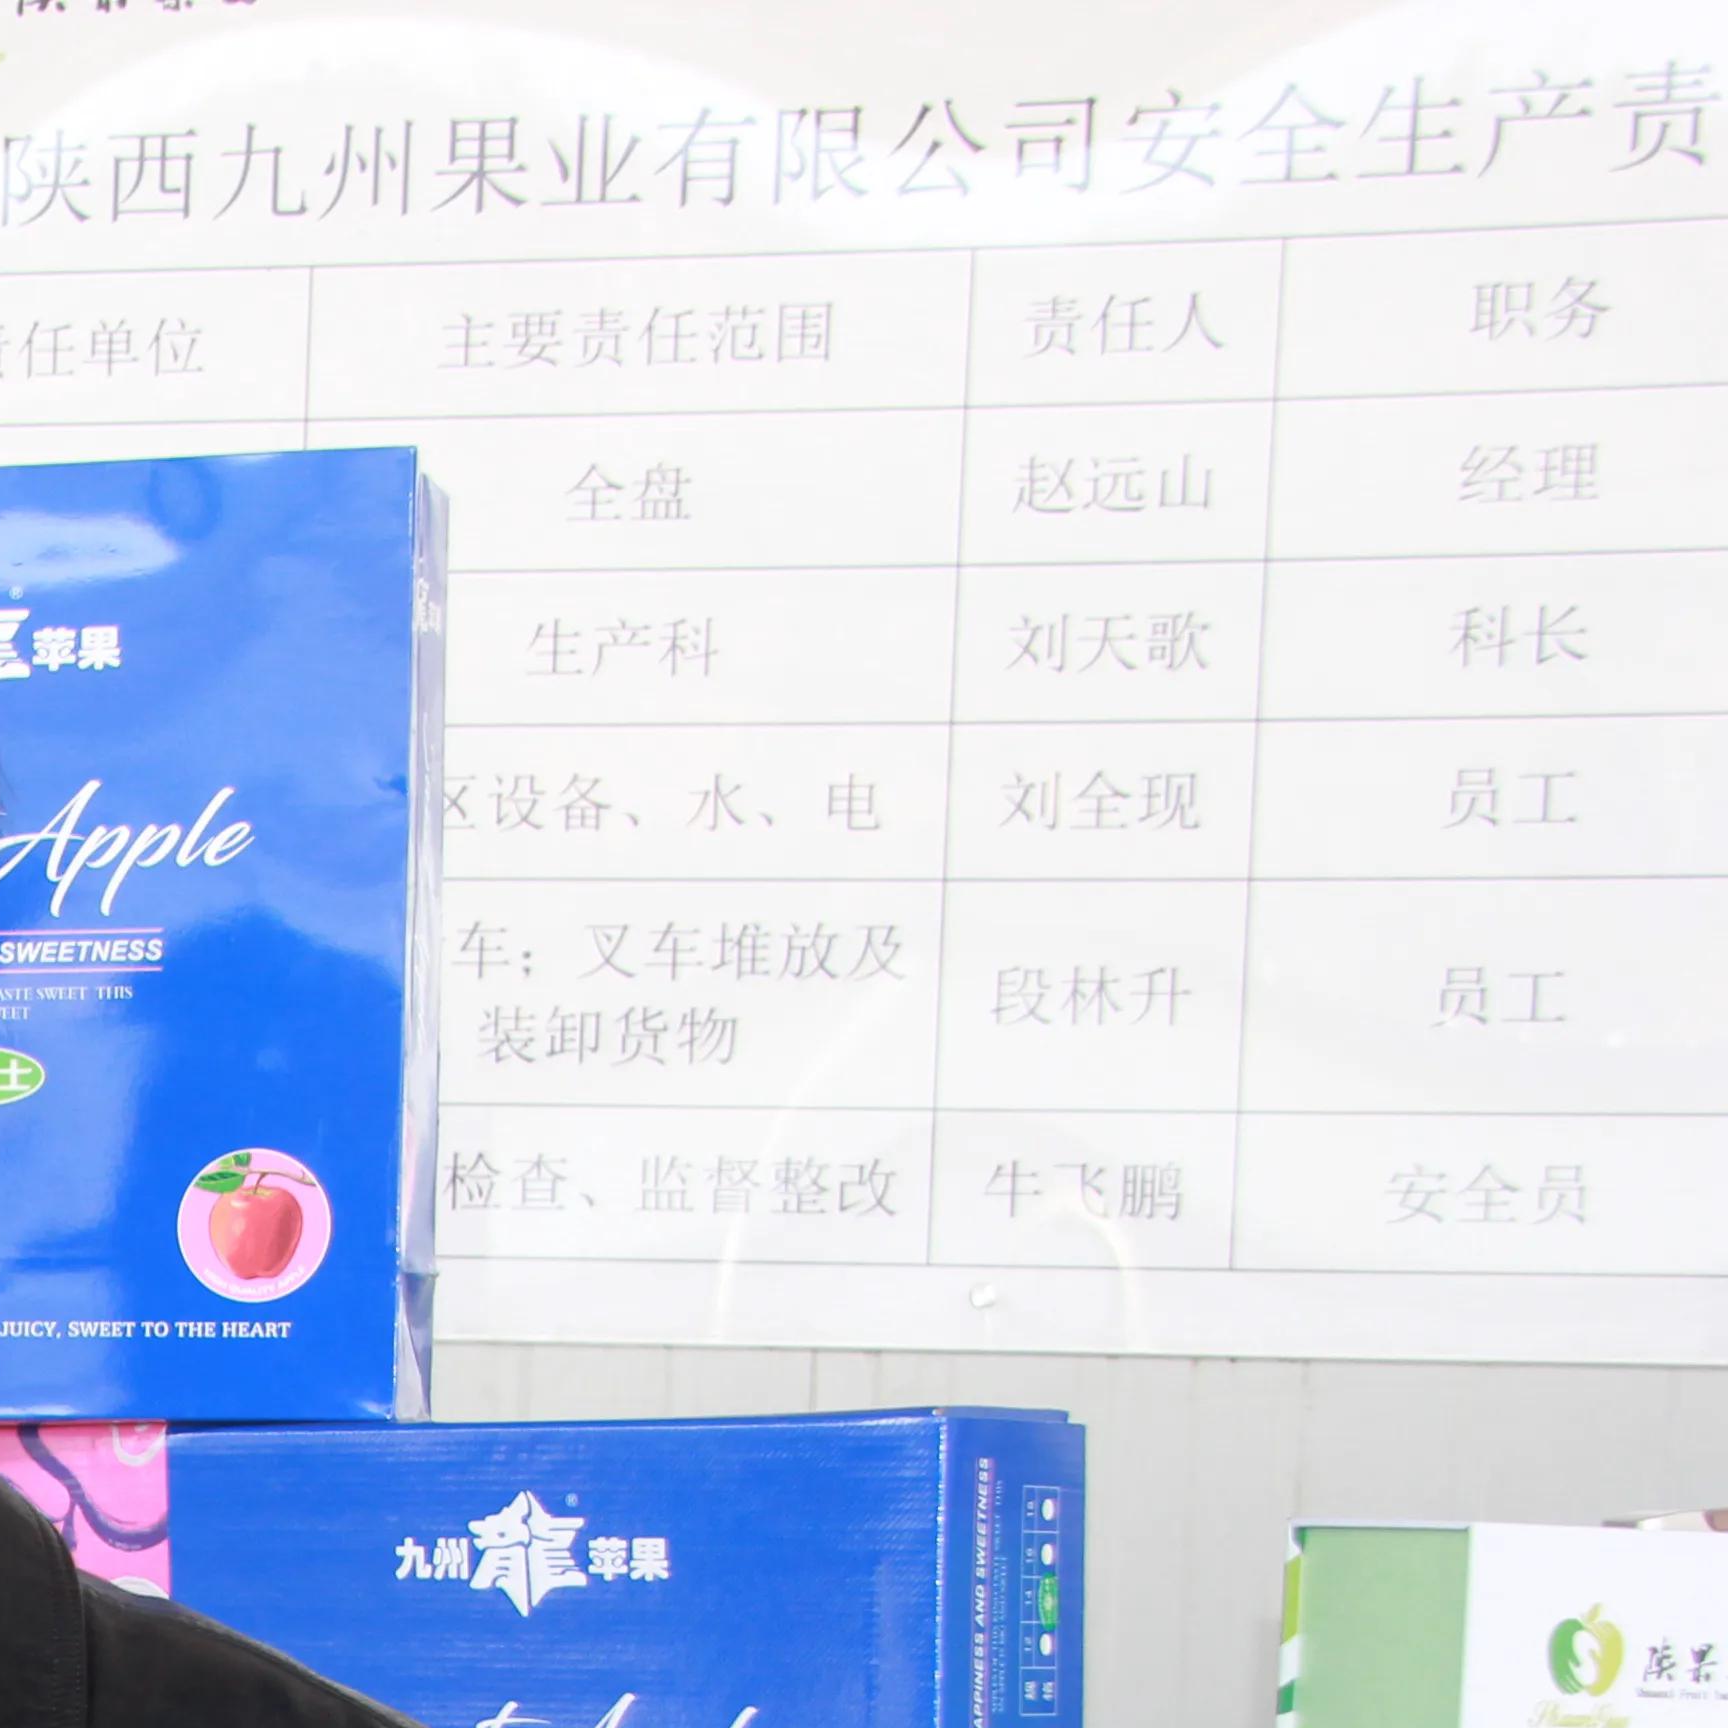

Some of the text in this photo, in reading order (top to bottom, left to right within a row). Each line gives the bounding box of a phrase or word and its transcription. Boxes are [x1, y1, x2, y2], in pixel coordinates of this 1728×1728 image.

[0, 58, 1718, 228] 陕西九州果业有限公司安全生产责
[436, 300, 836, 372] 主要责任范围
[1022, 293, 1228, 361] 责任人
[1467, 275, 1614, 347] 职务
[568, 461, 694, 525] 全盘
[1010, 453, 1216, 519] 赵远山
[1456, 442, 1603, 509] 经理
[525, 616, 722, 680] 生产科
[1007, 612, 1212, 675] 刘天歌
[1449, 604, 1590, 669] 科长
[999, 771, 1204, 834] 刘全现
[1440, 767, 1579, 831] 员工
[989, 965, 1194, 1027] 段林升
[1431, 965, 1568, 1029] 员工
[477, 1007, 741, 1069] 装卸货物
[444, 1156, 900, 1220] 检查、监督整改
[984, 1158, 1185, 1221] 牛飞鹏
[1383, 1163, 1590, 1225] 安全员
[67, 1319, 135, 1339] SWEET
[143, 1319, 170, 1339] TO
[174, 1319, 216, 1339] THE
[221, 1319, 292, 1340] HEART
